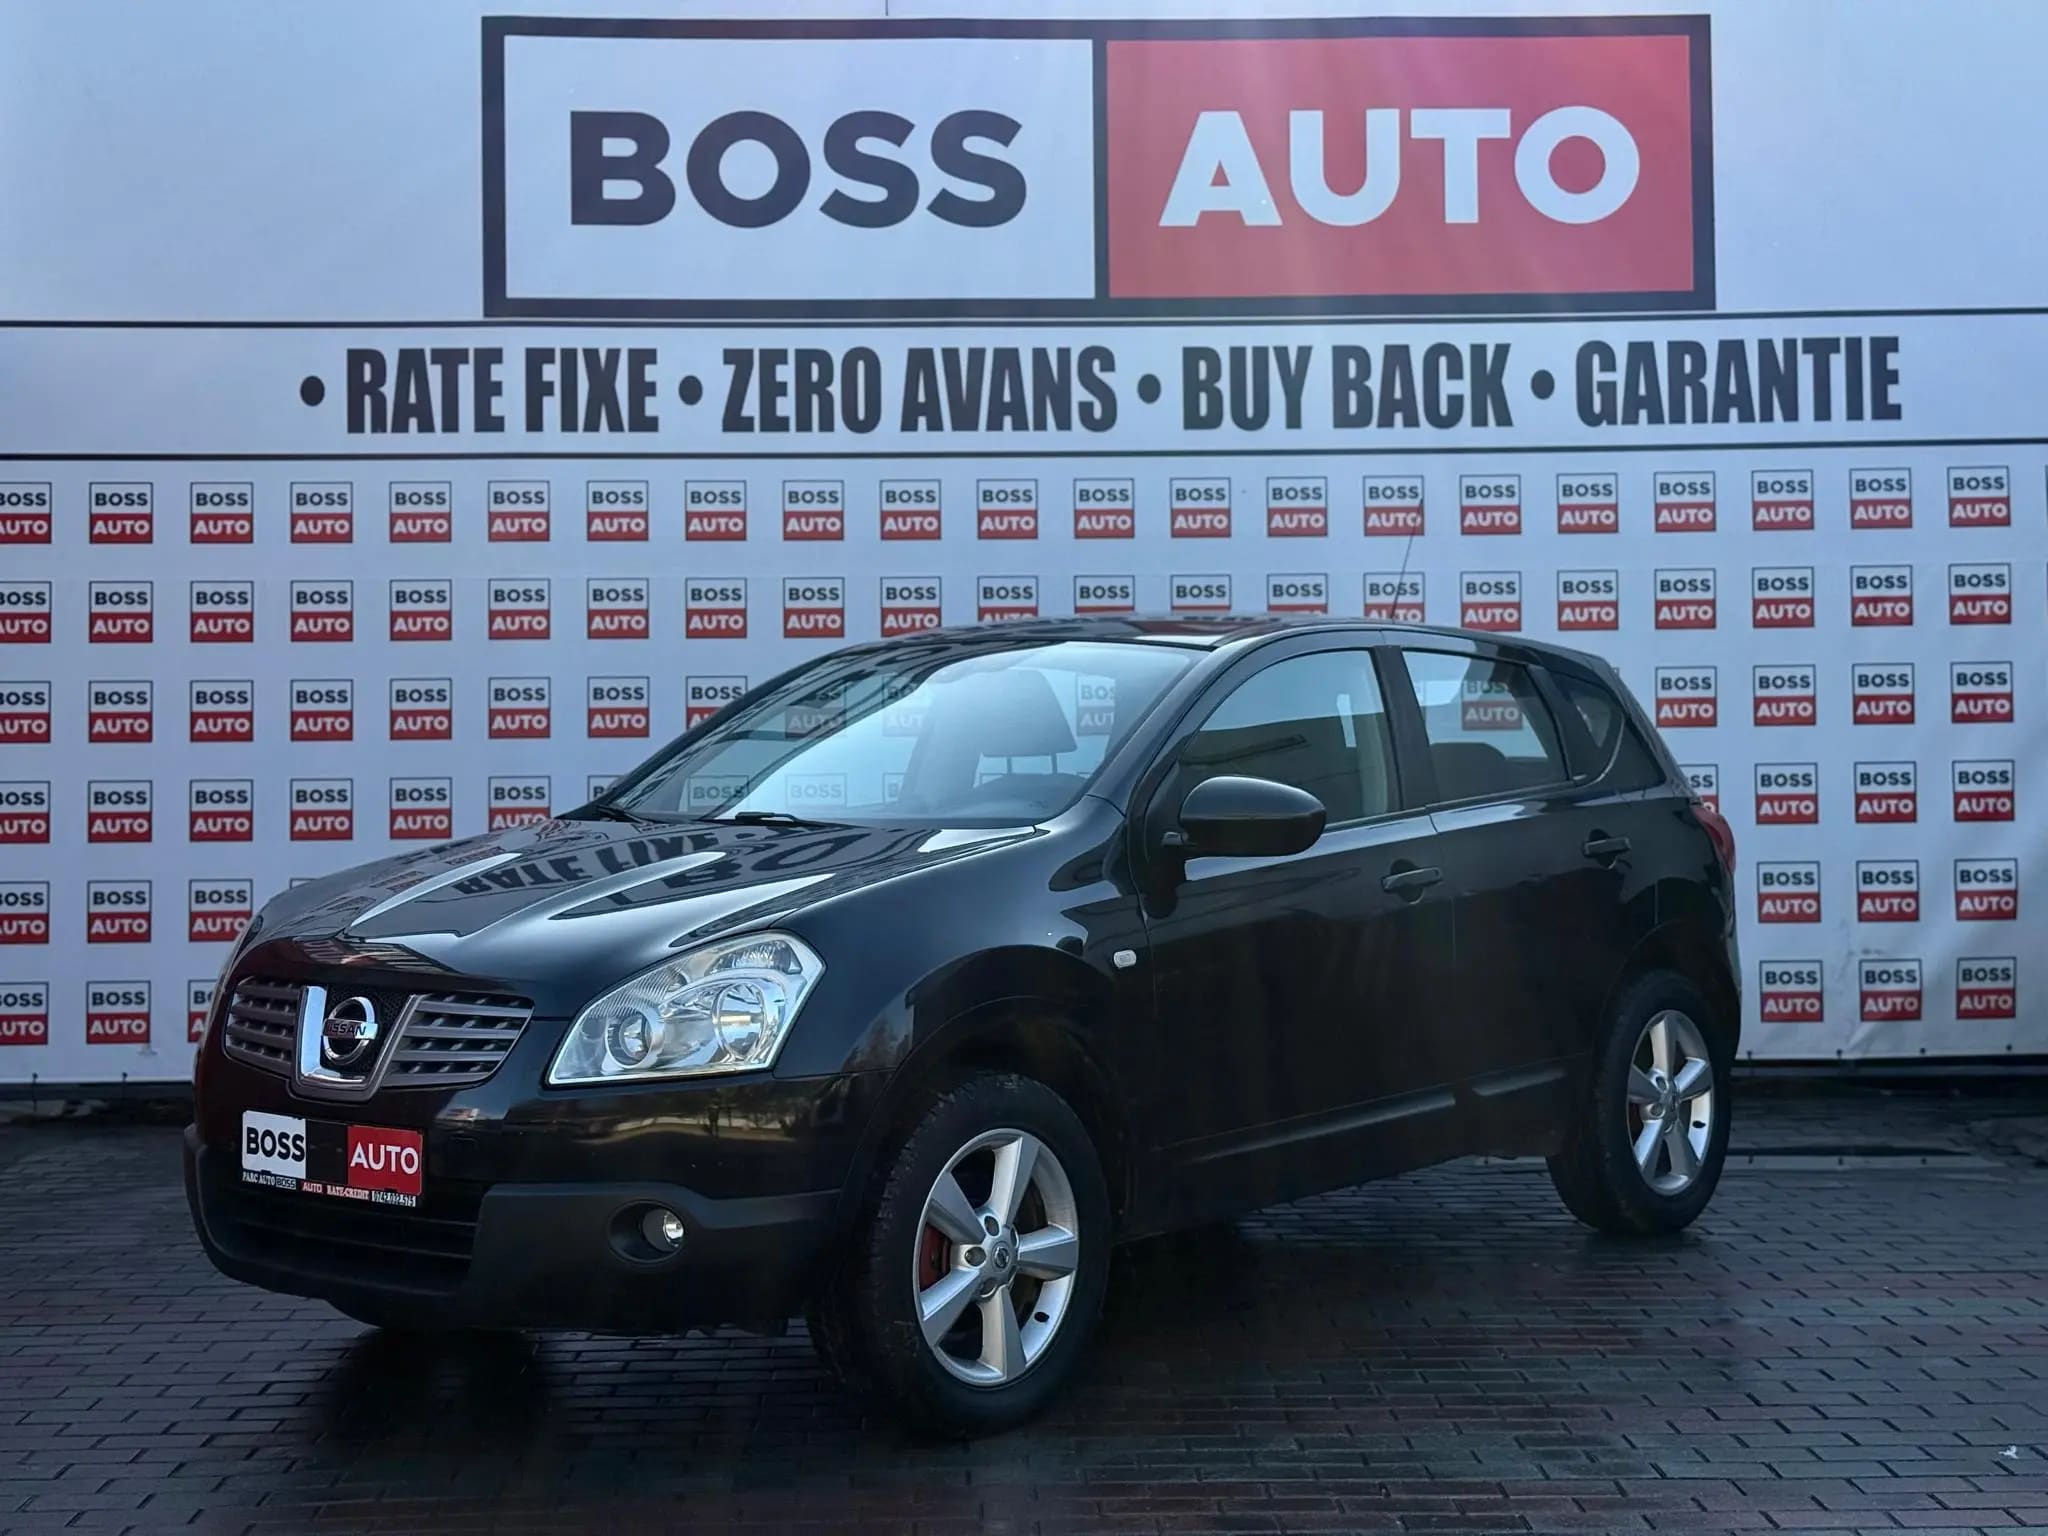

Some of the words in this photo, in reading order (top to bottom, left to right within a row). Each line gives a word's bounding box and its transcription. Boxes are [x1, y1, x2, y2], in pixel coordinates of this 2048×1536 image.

[571, 110, 1026, 228] BOSS
[1159, 106, 1640, 226] AUTO
[347, 348, 504, 434] RATE
[526, 348, 658, 432] FIXE
[722, 347, 881, 434] ZERO
[901, 346, 1117, 432] AVANS
[1183, 346, 1312, 430] BUY
[1333, 343, 1513, 428] BACK
[1576, 336, 1902, 427] GARANTIE
[1563, 484, 1613, 497] BOSS
[1660, 482, 1710, 495] BOSS
[1758, 480, 1808, 494] BOSS
[1856, 478, 1906, 492] BOSS
[1954, 477, 2004, 490] BOSS
[395, 492, 446, 505] BOSS
[494, 491, 544, 504] BOSS
[592, 491, 643, 504] BOSS
[691, 491, 741, 504] BOSS
[789, 491, 838, 504] BOSS
[886, 490, 936, 503] BOSS
[983, 489, 1032, 502] BOSS
[1079, 489, 1129, 502] BOSS
[1176, 488, 1225, 501] BOSS
[1272, 487, 1322, 500] BOSS
[1369, 486, 1419, 499] BOSS
[1466, 485, 1515, 498] BOSS
[95, 493, 147, 506] BOSS
[196, 493, 248, 506] BOSS
[296, 493, 347, 506] BOSS
[1561, 510, 1615, 524] AUTO
[1659, 509, 1712, 523] AUTO
[1756, 507, 1810, 521] AUTO
[1855, 505, 1908, 520] AUTO
[1953, 504, 2007, 518] AUTO
[394, 519, 448, 533] AUTO
[492, 518, 546, 532] AUTO
[591, 518, 645, 532] AUTO
[689, 518, 743, 531] AUTO
[787, 518, 841, 531] AUTO
[884, 517, 938, 531] AUTO
[981, 516, 1035, 530] AUTO
[1078, 516, 1131, 529] AUTO
[1175, 515, 1228, 528] AUTO
[1271, 514, 1324, 528] AUTO
[1368, 513, 1421, 527] AUTO
[1464, 512, 1518, 526] AUTO
[93, 520, 149, 534] AUTO
[194, 520, 250, 534] AUTO
[294, 520, 349, 534] AUTO
[1563, 580, 1613, 594] BOSS
[1660, 579, 1710, 592] BOSS
[1758, 577, 1808, 591] BOSS
[1856, 576, 1907, 589] BOSS
[1955, 574, 2005, 587] BOSS
[494, 589, 545, 602] BOSS
[593, 589, 643, 602] BOSS
[691, 588, 742, 601] BOSS
[789, 588, 839, 600] BOSS
[886, 587, 936, 600] BOSS
[983, 586, 1033, 599] BOSS
[1080, 586, 1129, 599] BOSS
[1176, 585, 1226, 598] BOSS
[1273, 584, 1322, 597] BOSS
[1369, 583, 1420, 596] BOSS
[1466, 582, 1516, 595] BOSS
[95, 592, 147, 605] BOSS
[196, 592, 248, 605] BOSS
[296, 591, 348, 604] BOSS
[396, 590, 446, 603] BOSS
[1561, 607, 1615, 621] AUTO
[1659, 606, 1712, 620] AUTO
[1757, 604, 1810, 619] AUTO
[1855, 602, 1909, 617] AUTO
[1954, 601, 2008, 615] AUTO
[591, 616, 645, 629] AUTO
[690, 615, 743, 629] AUTO
[787, 615, 841, 629] AUTO
[885, 614, 939, 629] AUTO
[1465, 608, 1518, 623] AUTO
[93, 619, 149, 633] AUTO
[195, 619, 249, 633] AUTO
[295, 618, 349, 632] AUTO
[394, 617, 448, 631] AUTO
[492, 616, 547, 630] AUTO
[1661, 677, 1711, 690] BOSS
[1759, 676, 1810, 689] BOSS
[1858, 674, 1909, 687] BOSS
[1957, 672, 2007, 686] BOSS
[95, 691, 147, 705] BOSS
[196, 691, 248, 704] BOSS
[296, 690, 348, 703] BOSS
[396, 689, 447, 702] BOSS
[494, 688, 545, 701] BOSS
[593, 687, 644, 700] BOSS
[692, 687, 742, 700] BOSS
[1659, 704, 1713, 718] AUTO
[1757, 702, 1812, 717] AUTO
[1857, 701, 1911, 715] AUTO
[1955, 699, 2010, 714] AUTO
[592, 714, 646, 728] AUTO
[1466, 707, 1519, 721] AUTO
[93, 719, 149, 733] AUTO
[194, 718, 249, 732] AUTO
[294, 718, 349, 731] AUTO
[394, 716, 448, 730] AUTO
[492, 715, 547, 729] AUTO
[1761, 773, 1812, 787] BOSS
[1860, 772, 1911, 786] BOSS
[1959, 770, 2009, 784] BOSS
[94, 791, 147, 805] BOSS
[195, 790, 248, 804] BOSS
[296, 789, 347, 803] BOSS
[396, 788, 447, 801] BOSS
[494, 787, 545, 800] BOSS
[1760, 801, 1814, 815] AUTO
[1859, 800, 1913, 814] AUTO
[1958, 798, 2011, 812] AUTO
[92, 819, 148, 833] AUTO
[194, 818, 249, 832] AUTO
[294, 817, 349, 831] AUTO
[394, 815, 448, 829] AUTO
[1763, 872, 1815, 886] BOSS
[1862, 871, 1914, 884] BOSS
[1960, 869, 2012, 883] BOSS
[93, 891, 146, 905] BOSS
[195, 890, 247, 904] BOSS
[1960, 897, 2013, 911] AUTO
[1762, 899, 1816, 914] AUTO
[1862, 898, 1915, 912] AUTO
[91, 919, 147, 933] AUTO
[193, 918, 247, 932] AUTO
[1765, 971, 1817, 985] BOSS
[1861, 970, 1915, 984] BOSS
[1962, 968, 2011, 982] BOSS
[92, 992, 145, 1005] BOSS
[1864, 997, 1916, 1012] AUTO
[1960, 995, 2012, 1009] AUTO
[1764, 999, 1818, 1013] AUTO
[90, 1020, 146, 1034] AUTO
[246, 1126, 305, 1162] BOSS
[350, 1142, 419, 1175] AUTO
[259, 1173, 276, 1186] AUTO
[302, 1182, 323, 1193] AUTO
